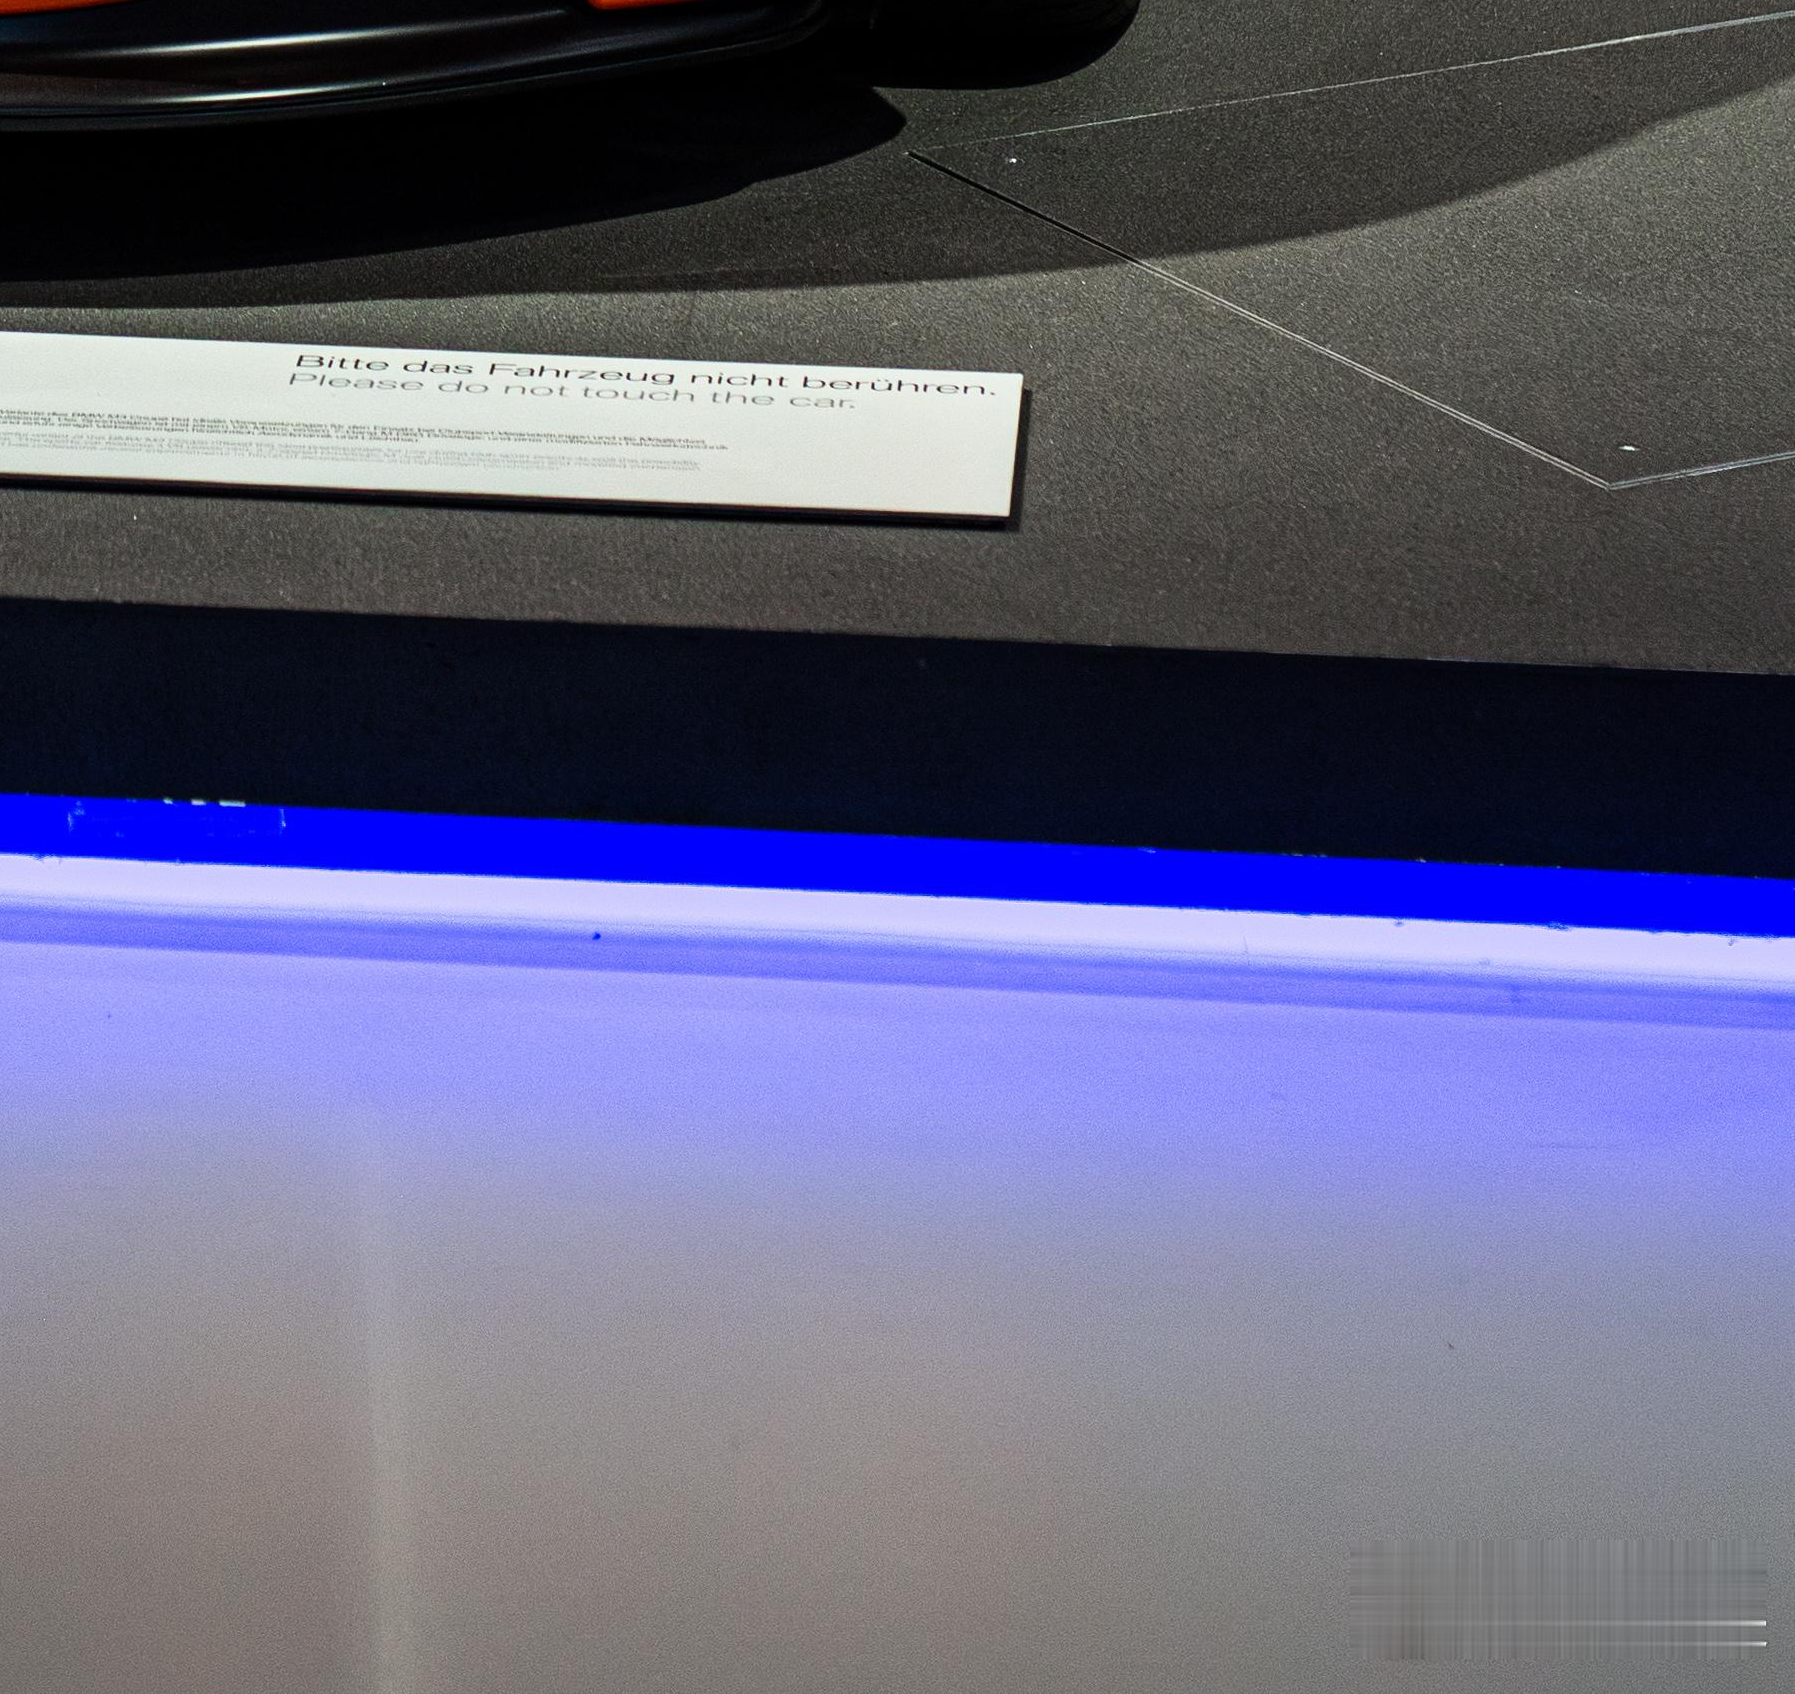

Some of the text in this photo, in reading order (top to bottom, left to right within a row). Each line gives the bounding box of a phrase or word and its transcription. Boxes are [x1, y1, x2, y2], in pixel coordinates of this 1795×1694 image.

[288, 372, 856, 410] Please do not touch the car.
[295, 354, 997, 396] Bitte das Fahrzeug nicht berühren.
